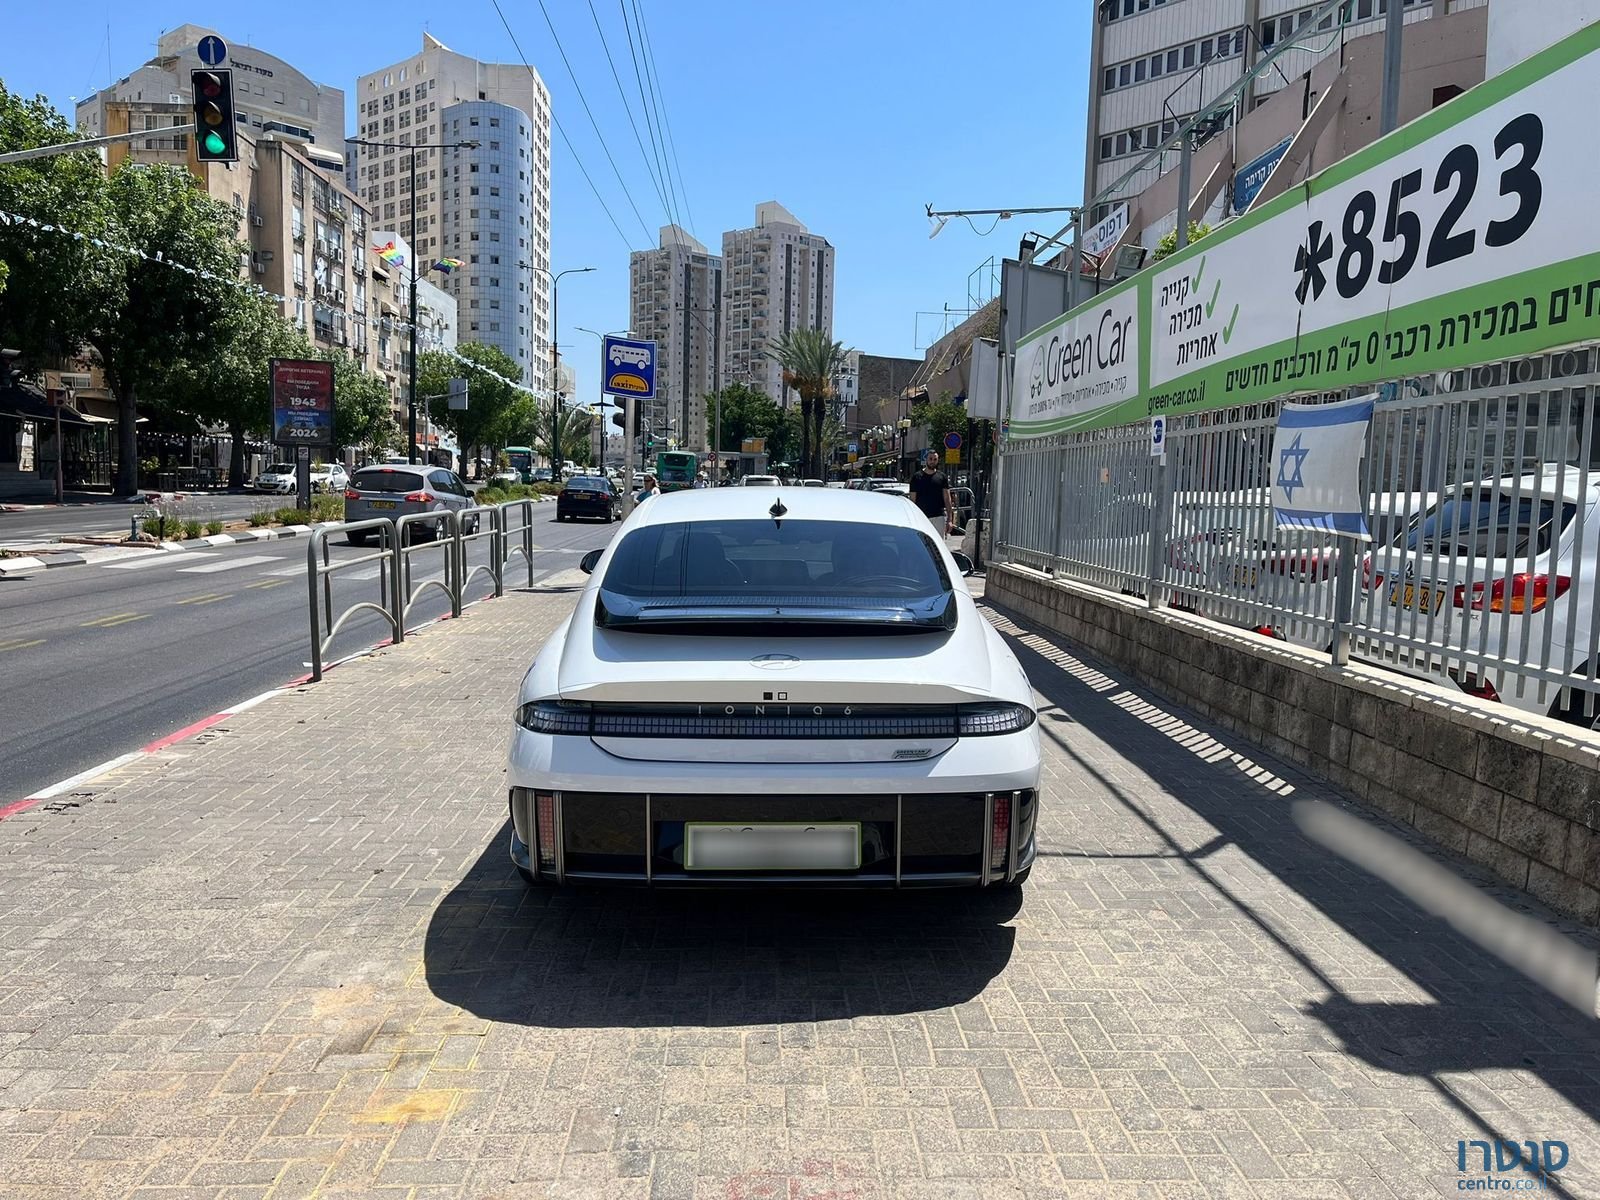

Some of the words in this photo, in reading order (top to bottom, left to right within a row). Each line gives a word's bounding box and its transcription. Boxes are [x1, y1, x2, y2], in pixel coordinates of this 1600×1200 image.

[1245, 166, 1266, 189] קדימה
[1099, 212, 1123, 243] דפוס
[1161, 275, 1190, 307] קנייה
[1169, 303, 1203, 336] מכירה
[1437, 297, 1538, 350] במכירת
[1047, 334, 1092, 388] Green
[1097, 309, 1132, 370] Car
[1176, 332, 1218, 366] אחריות
[1385, 324, 1431, 360] רכבי
[1225, 362, 1269, 392] חדשים
[1272, 349, 1322, 383] ורכבים
[290, 397, 316, 407] 1945
[1148, 380, 1206, 415] green-car.co.il
[290, 428, 318, 438] 2024
